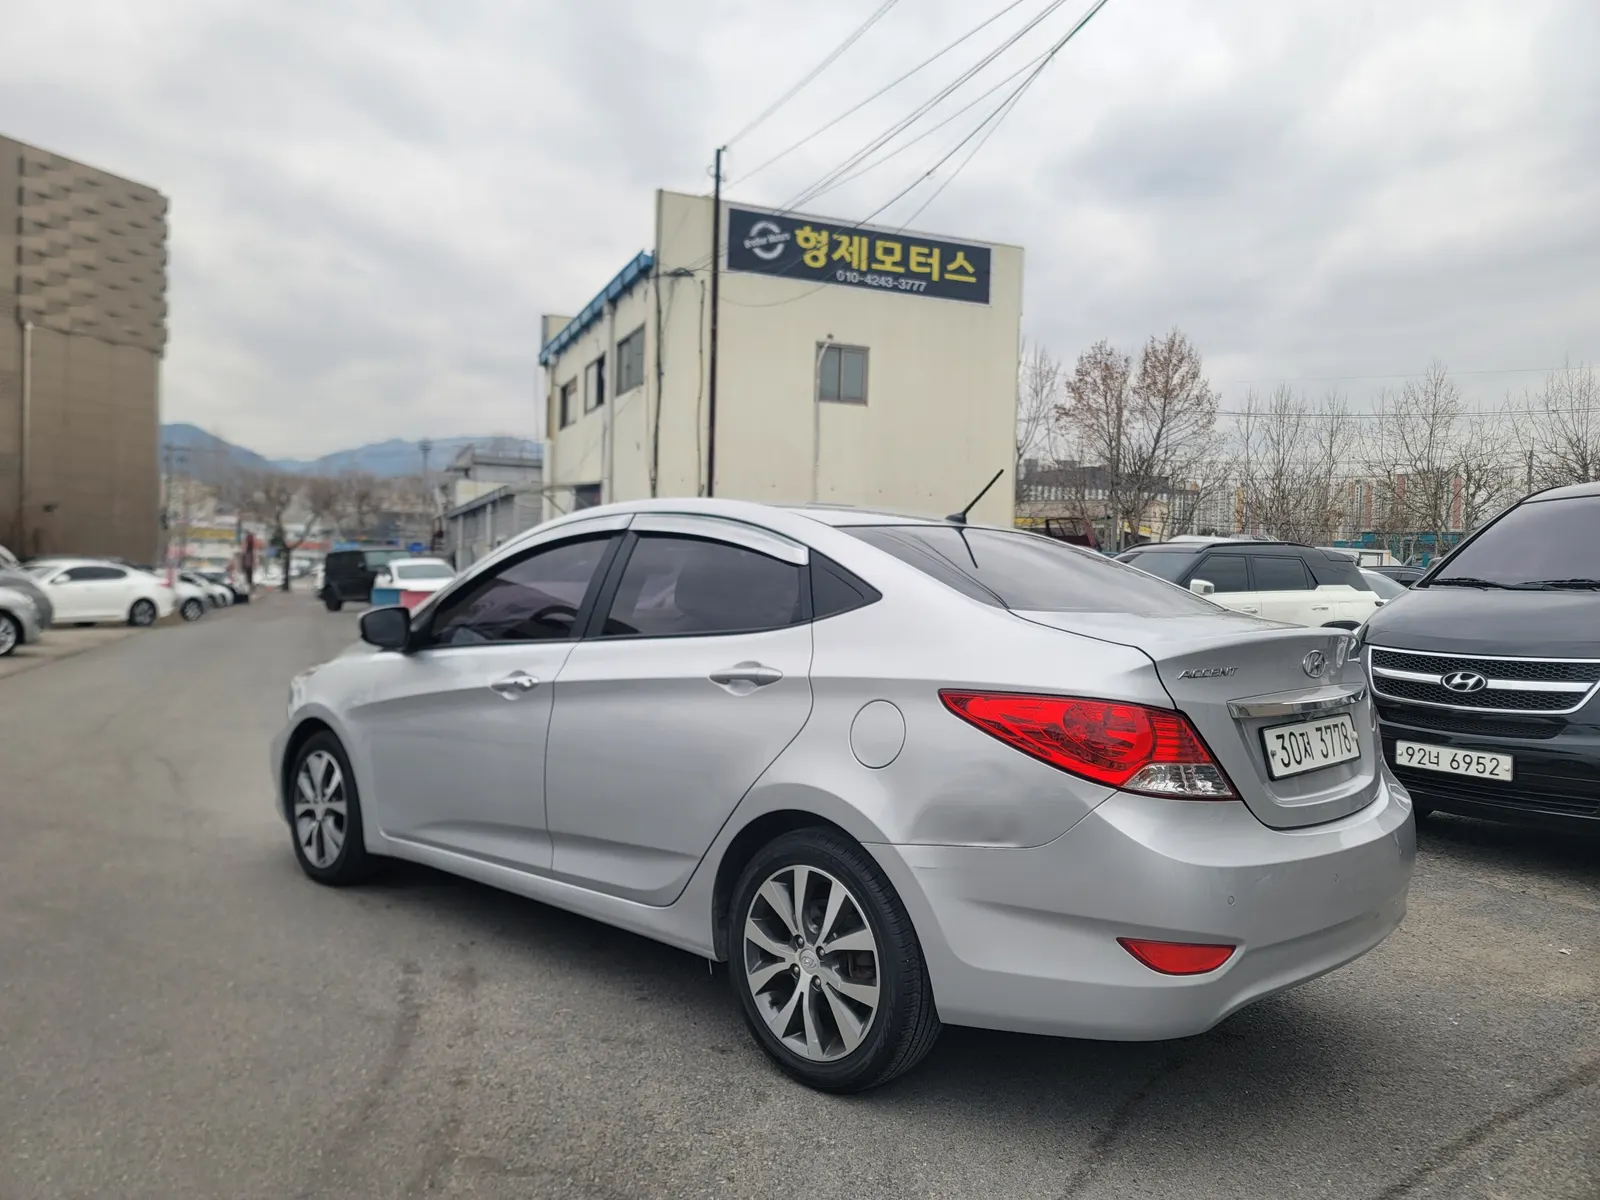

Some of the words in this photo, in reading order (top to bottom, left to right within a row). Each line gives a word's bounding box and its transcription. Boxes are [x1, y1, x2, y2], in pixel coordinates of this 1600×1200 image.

[795, 226, 977, 283] 형제모터스
[836, 270, 927, 292] 010-4243-3777
[1177, 666, 1239, 680] ACCENT
[1275, 731, 1315, 768] 30저
[1315, 721, 1352, 759] 3778
[1405, 746, 1440, 767] 92너
[1449, 753, 1500, 776] 6952
